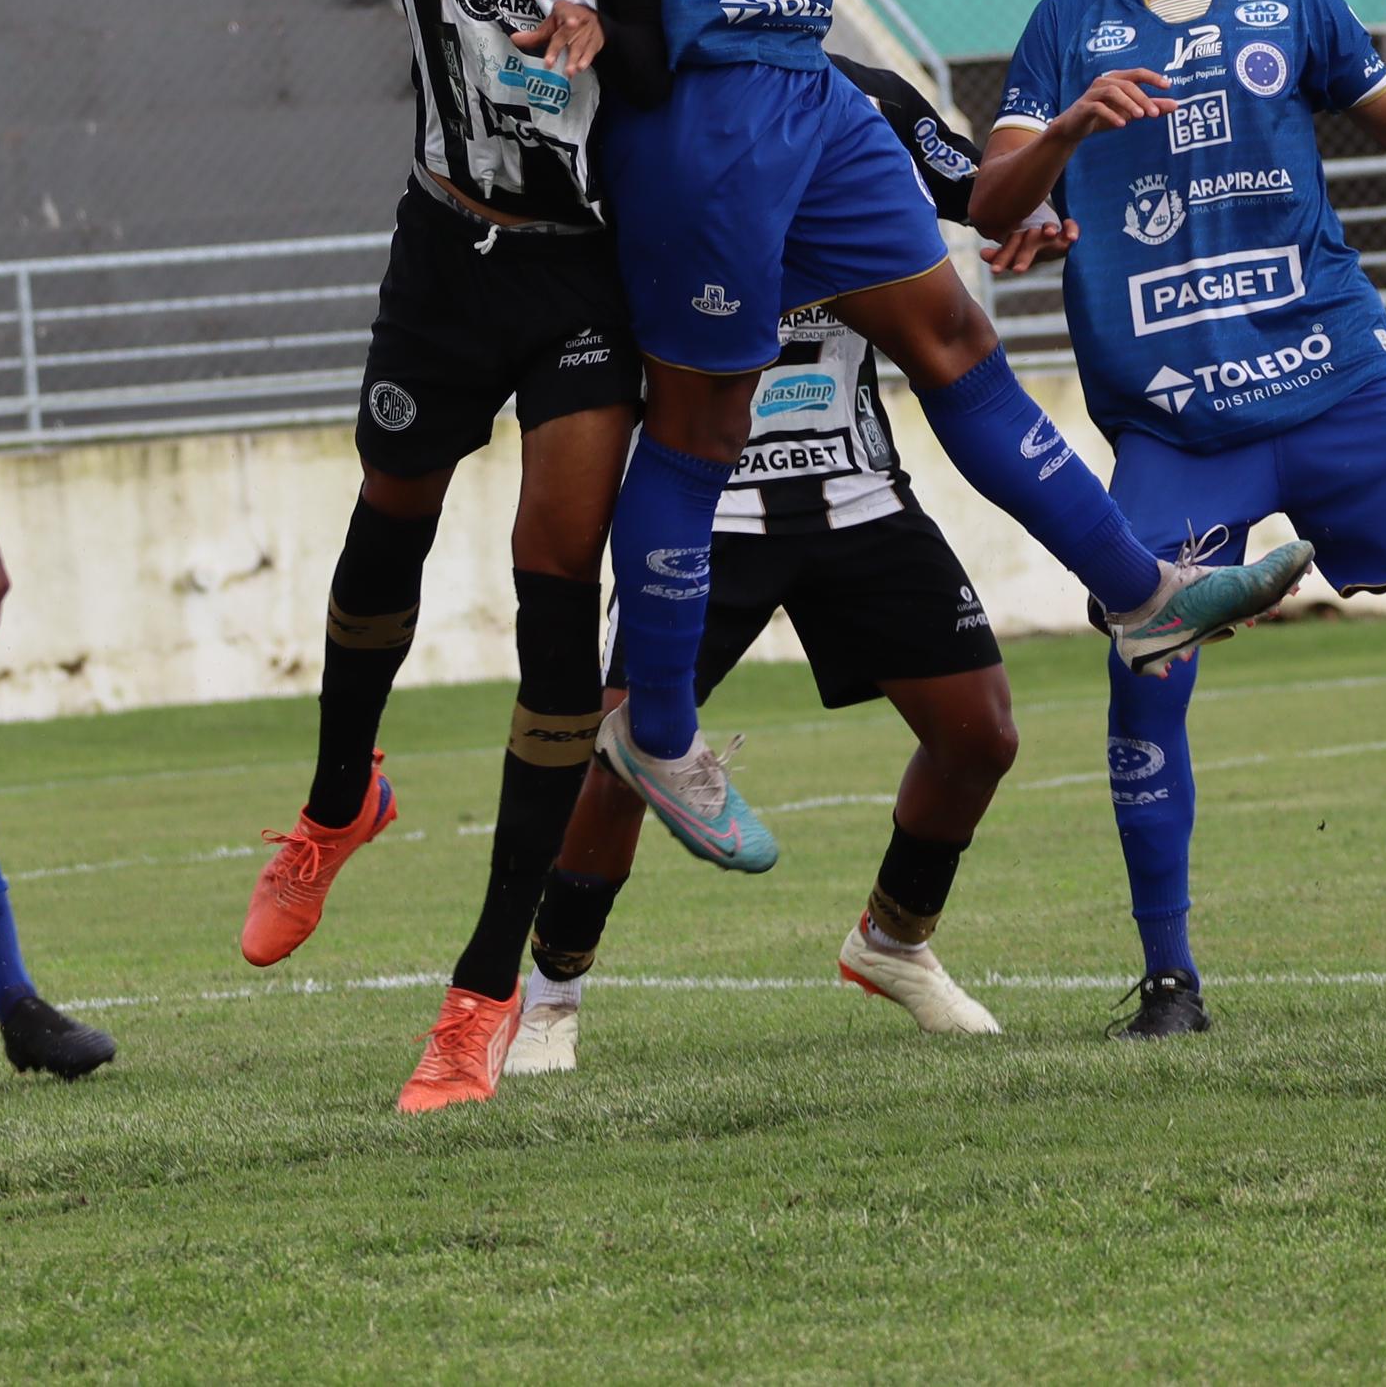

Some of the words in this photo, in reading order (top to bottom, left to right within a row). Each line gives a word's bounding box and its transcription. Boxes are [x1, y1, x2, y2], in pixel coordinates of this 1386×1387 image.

[1245, 13, 1281, 23] LUIZ
[1093, 35, 1130, 50] LUIZ
[1173, 73, 1194, 86] Hiper
[1195, 66, 1227, 80] Popular
[1173, 100, 1221, 127] PAG
[915, 119, 963, 167] Oops
[1175, 119, 1223, 145] BET
[1188, 168, 1293, 199] ARAPIRACA
[1153, 266, 1280, 315] PAGBET
[565, 334, 604, 349] GIGANTE
[792, 331, 825, 341] CIDADE
[558, 348, 611, 369] PRATIC
[1194, 331, 1333, 394] TOLEDO
[761, 382, 832, 406] Braslimp
[1213, 359, 1335, 413] DISTRIBUIDOR
[734, 445, 837, 476] PAGBET
